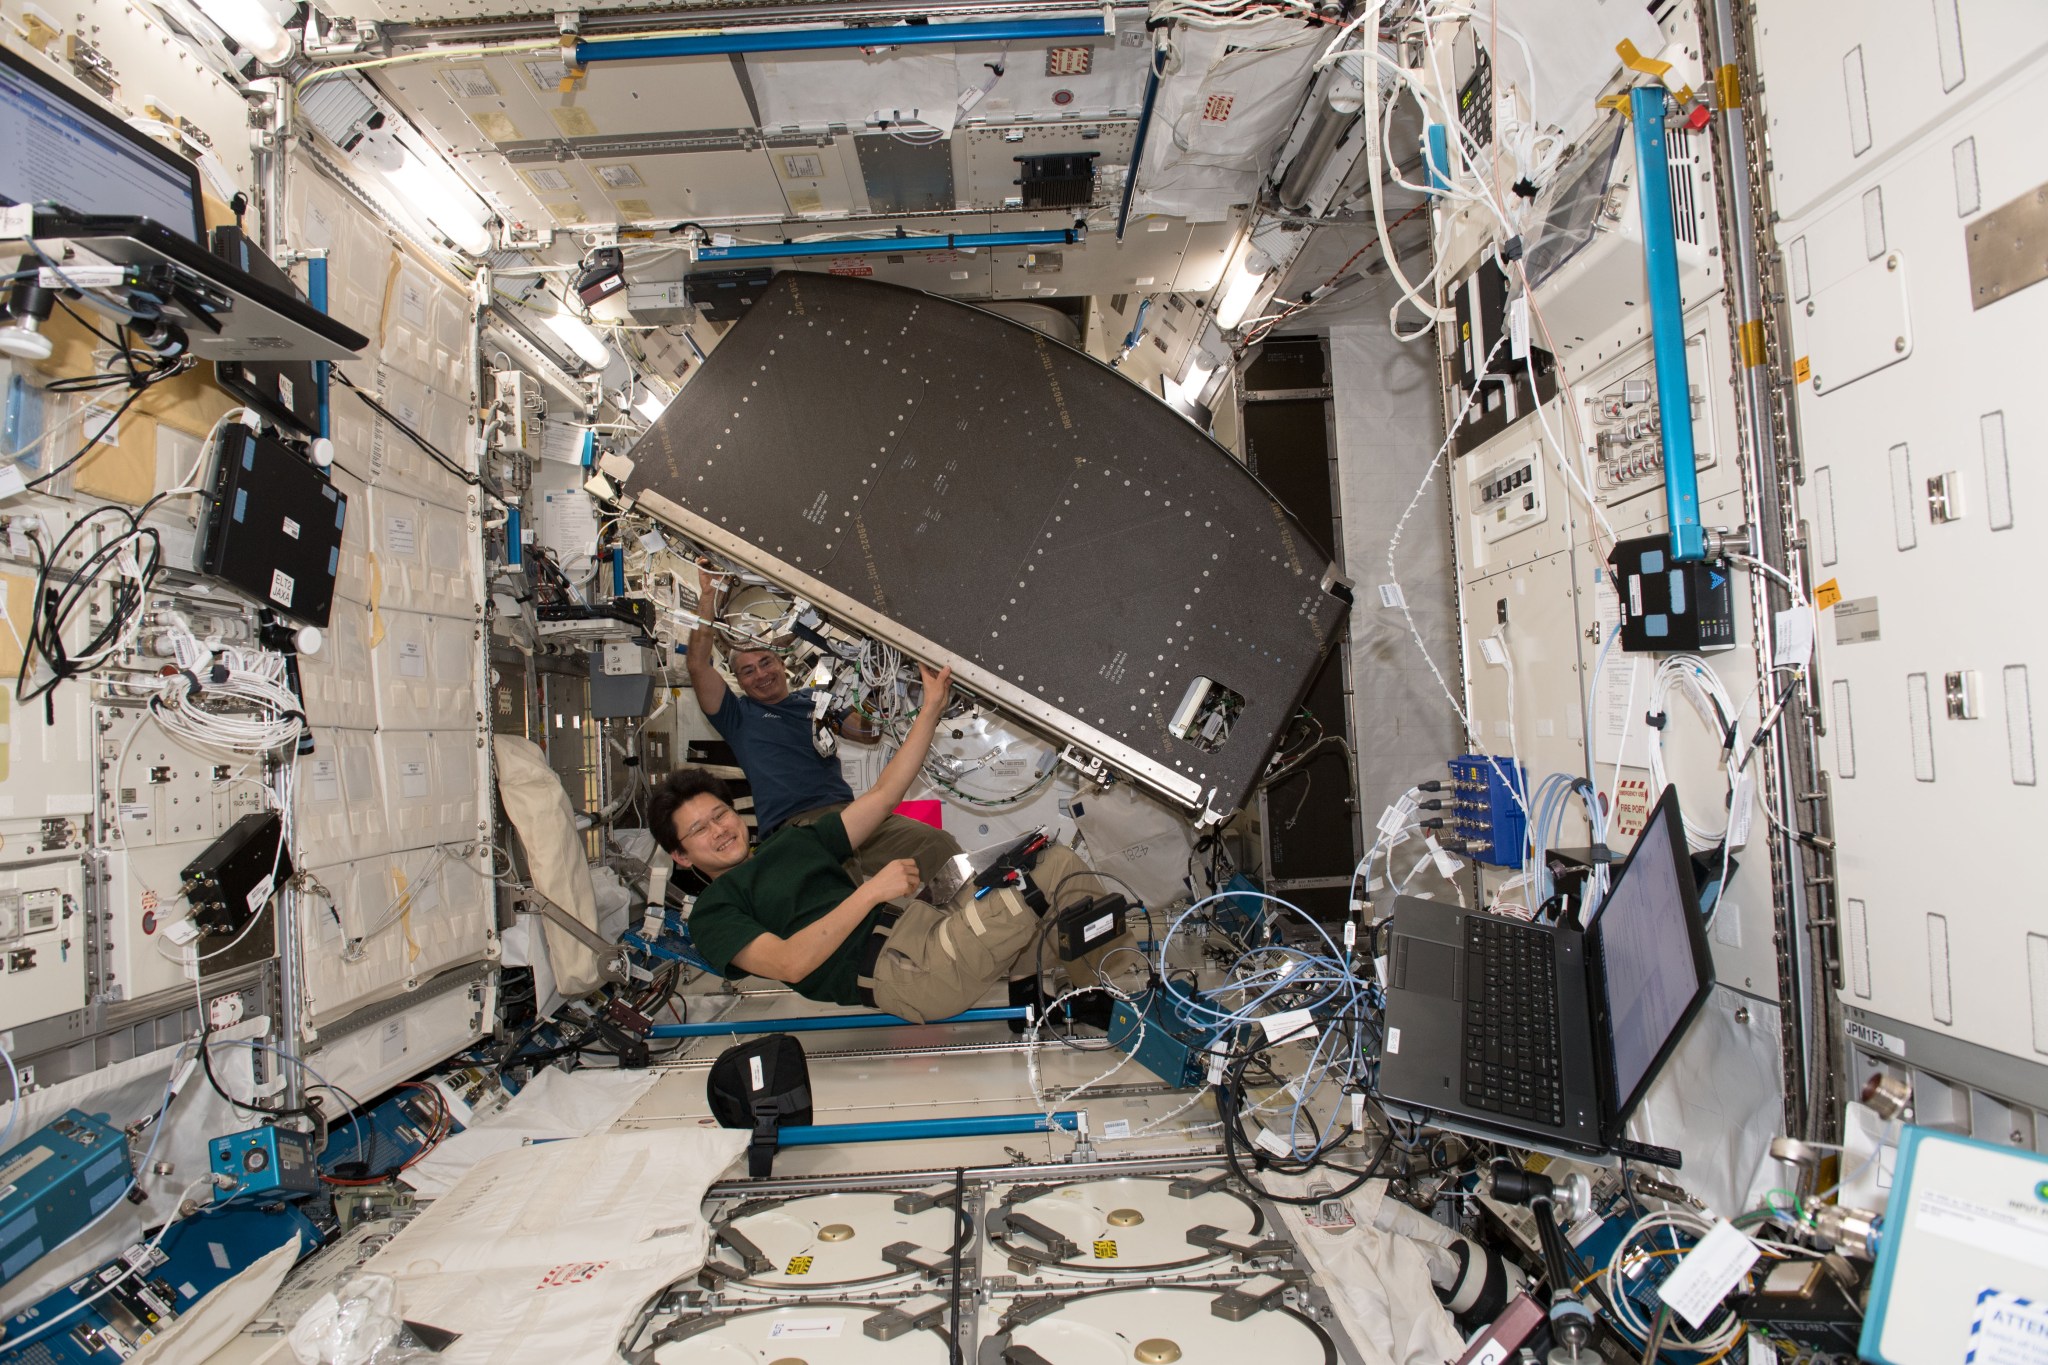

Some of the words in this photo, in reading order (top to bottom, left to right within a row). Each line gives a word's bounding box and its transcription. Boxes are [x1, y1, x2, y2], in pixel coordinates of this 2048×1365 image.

[275, 574, 292, 591] ELT2
[273, 587, 290, 603] JAXA
[1620, 803, 1632, 813] FIRE
[1632, 804, 1645, 814] PORT
[1122, 844, 1149, 862] 4281
